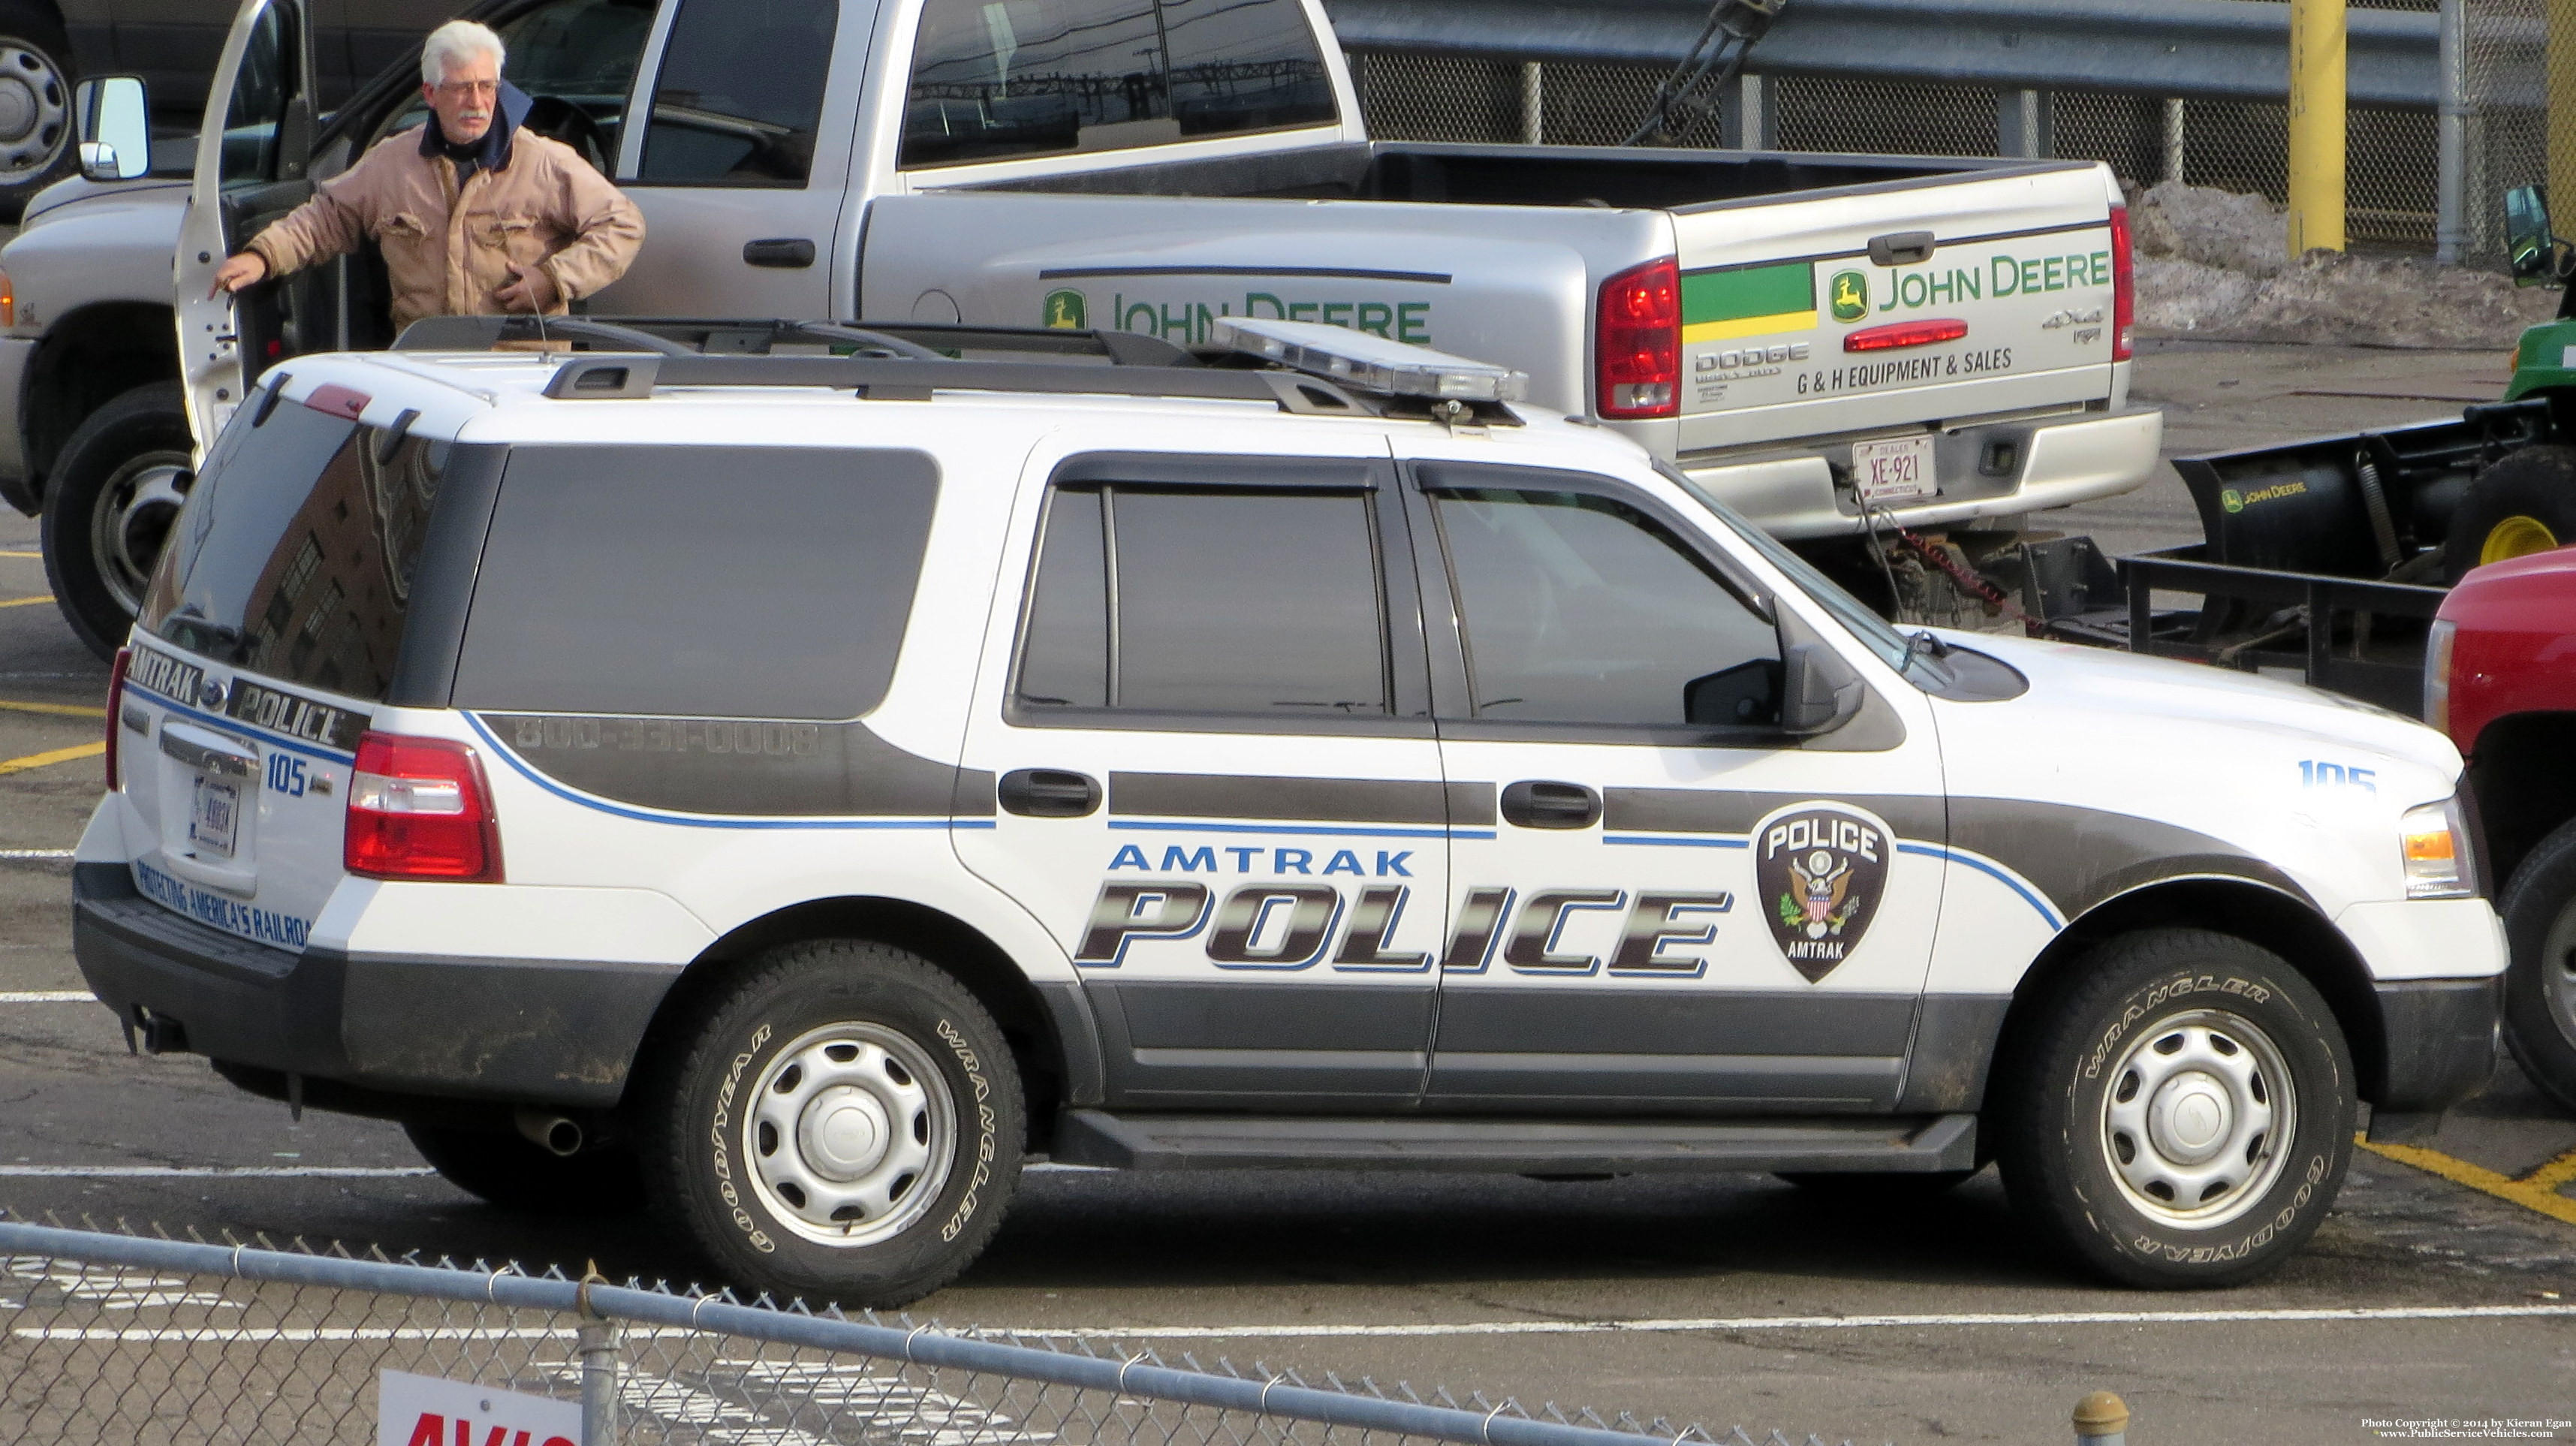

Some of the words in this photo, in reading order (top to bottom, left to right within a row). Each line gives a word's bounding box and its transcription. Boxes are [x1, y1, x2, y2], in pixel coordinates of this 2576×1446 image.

[1879, 267, 1981, 313] JOHN
[1991, 252, 2111, 299] DEERE
[1115, 292, 1229, 344] JOHN
[1695, 342, 1810, 372] DODGE
[1797, 373, 1808, 394] G
[1813, 371, 1825, 392] &
[1832, 368, 1842, 390] H
[1848, 357, 1941, 388] EQUIPMENT
[1946, 354, 1957, 375] &
[1964, 348, 2012, 374] SALES
[2245, 490, 2273, 505] JOHN
[2270, 482, 2307, 499] DEERE
[125, 644, 197, 703] AMTRAK
[268, 752, 306, 797] 105
[2298, 759, 2377, 794] 105
[1106, 844, 1415, 877] AMTRAK
[1767, 818, 1879, 863] POLICE
[190, 889, 252, 935] AMERICA'S
[1074, 880, 1735, 980] POLICE
[1787, 941, 1845, 959] AMTRAK
[2085, 975, 2270, 1079] WRANGLER
[710, 1024, 776, 1253] GOODYEAR
[937, 1019, 996, 1243] WRANGLER
[2135, 1155, 2324, 1264] GOODYEAR
